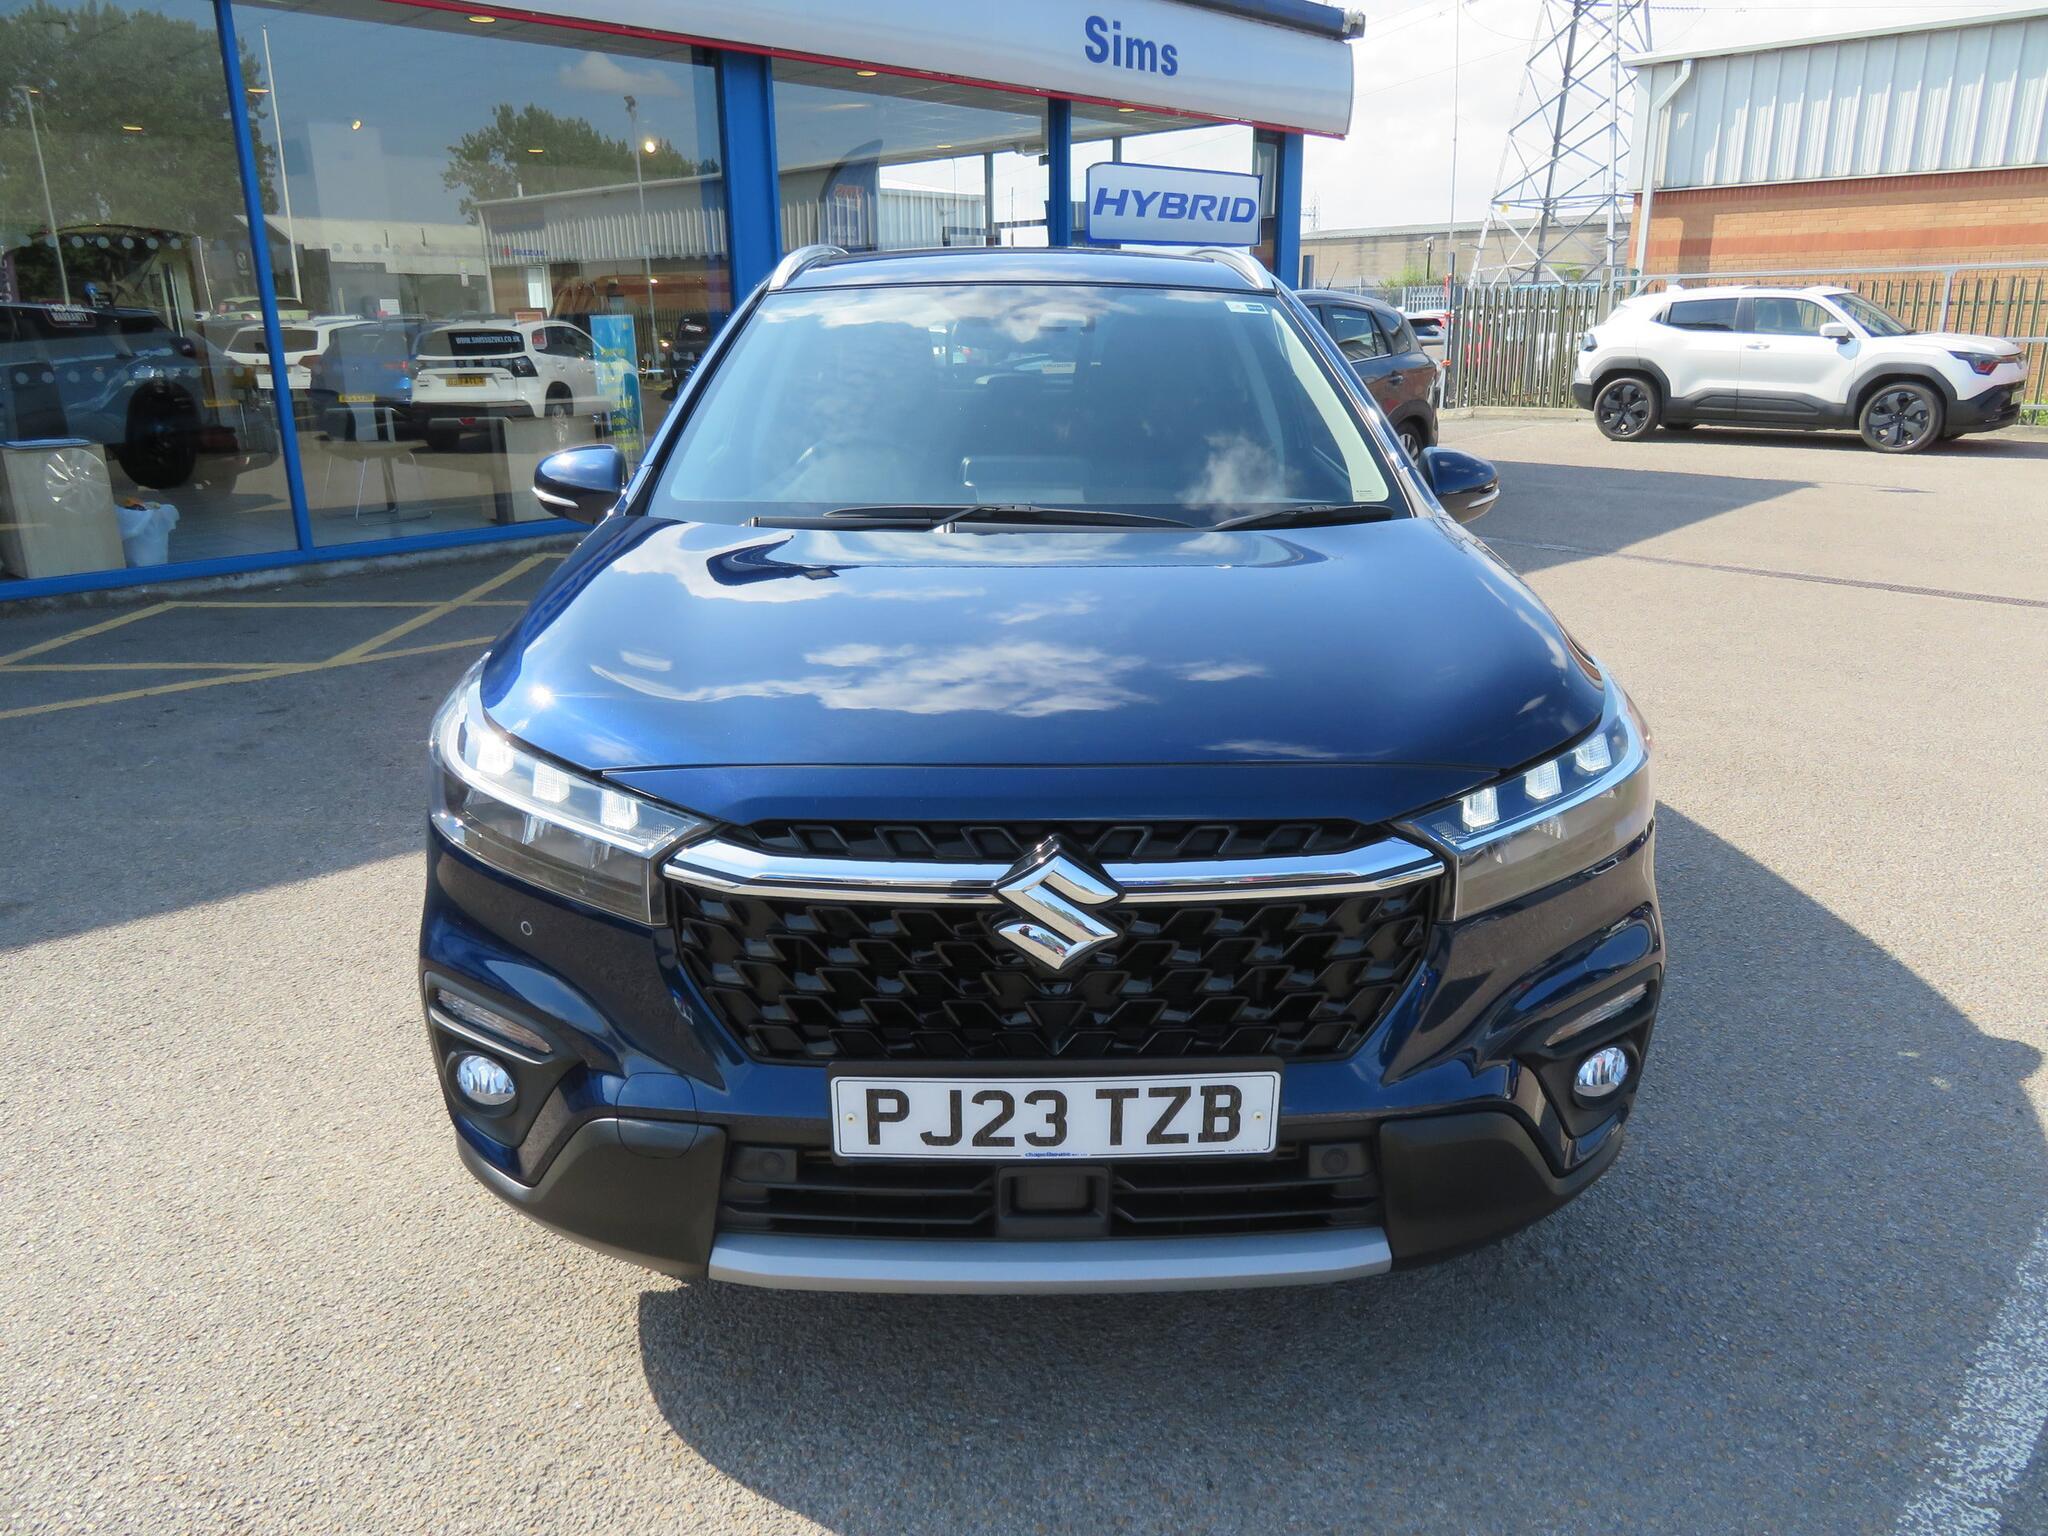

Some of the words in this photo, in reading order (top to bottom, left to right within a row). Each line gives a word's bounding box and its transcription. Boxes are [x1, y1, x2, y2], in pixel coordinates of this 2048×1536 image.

[1085, 15, 1178, 76] Sims
[1093, 187, 1257, 223] HYBRID
[866, 1088, 1068, 1147] PJ23
[1096, 1084, 1243, 1146] TZB
